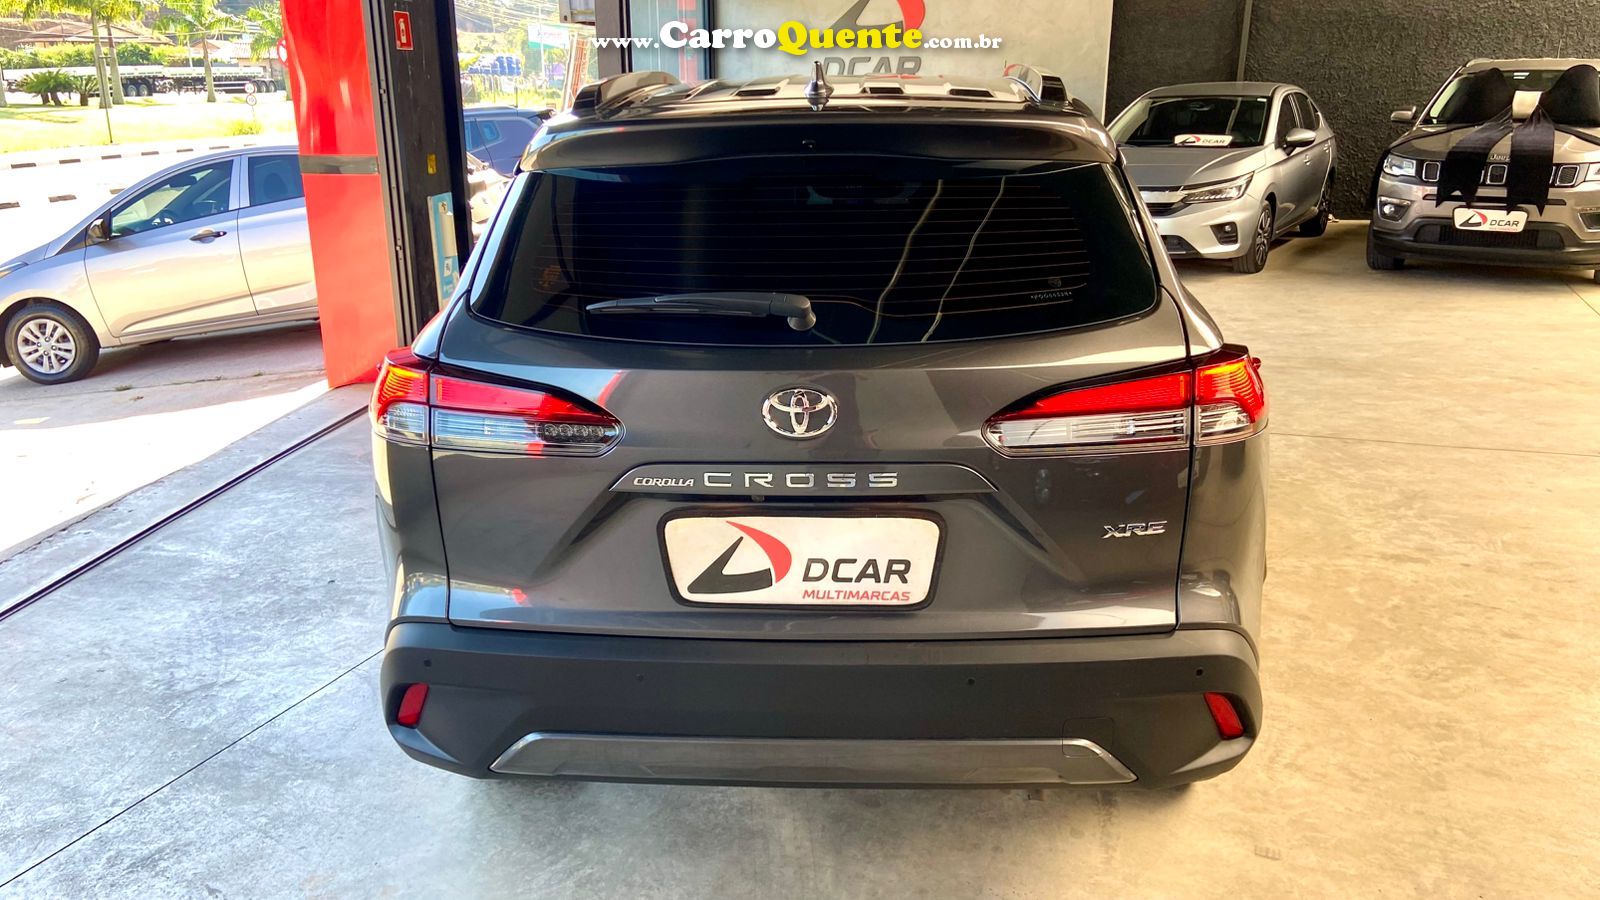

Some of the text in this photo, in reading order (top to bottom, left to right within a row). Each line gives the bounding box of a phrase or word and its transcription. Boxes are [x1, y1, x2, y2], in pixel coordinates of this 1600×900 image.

[1489, 219, 1520, 227] DCAR
[633, 477, 695, 487] COROLLA
[703, 472, 899, 488] CROSS
[1102, 520, 1167, 540] XRE
[801, 557, 912, 585] DCAR
[801, 588, 911, 602] MULTIMARCAS
